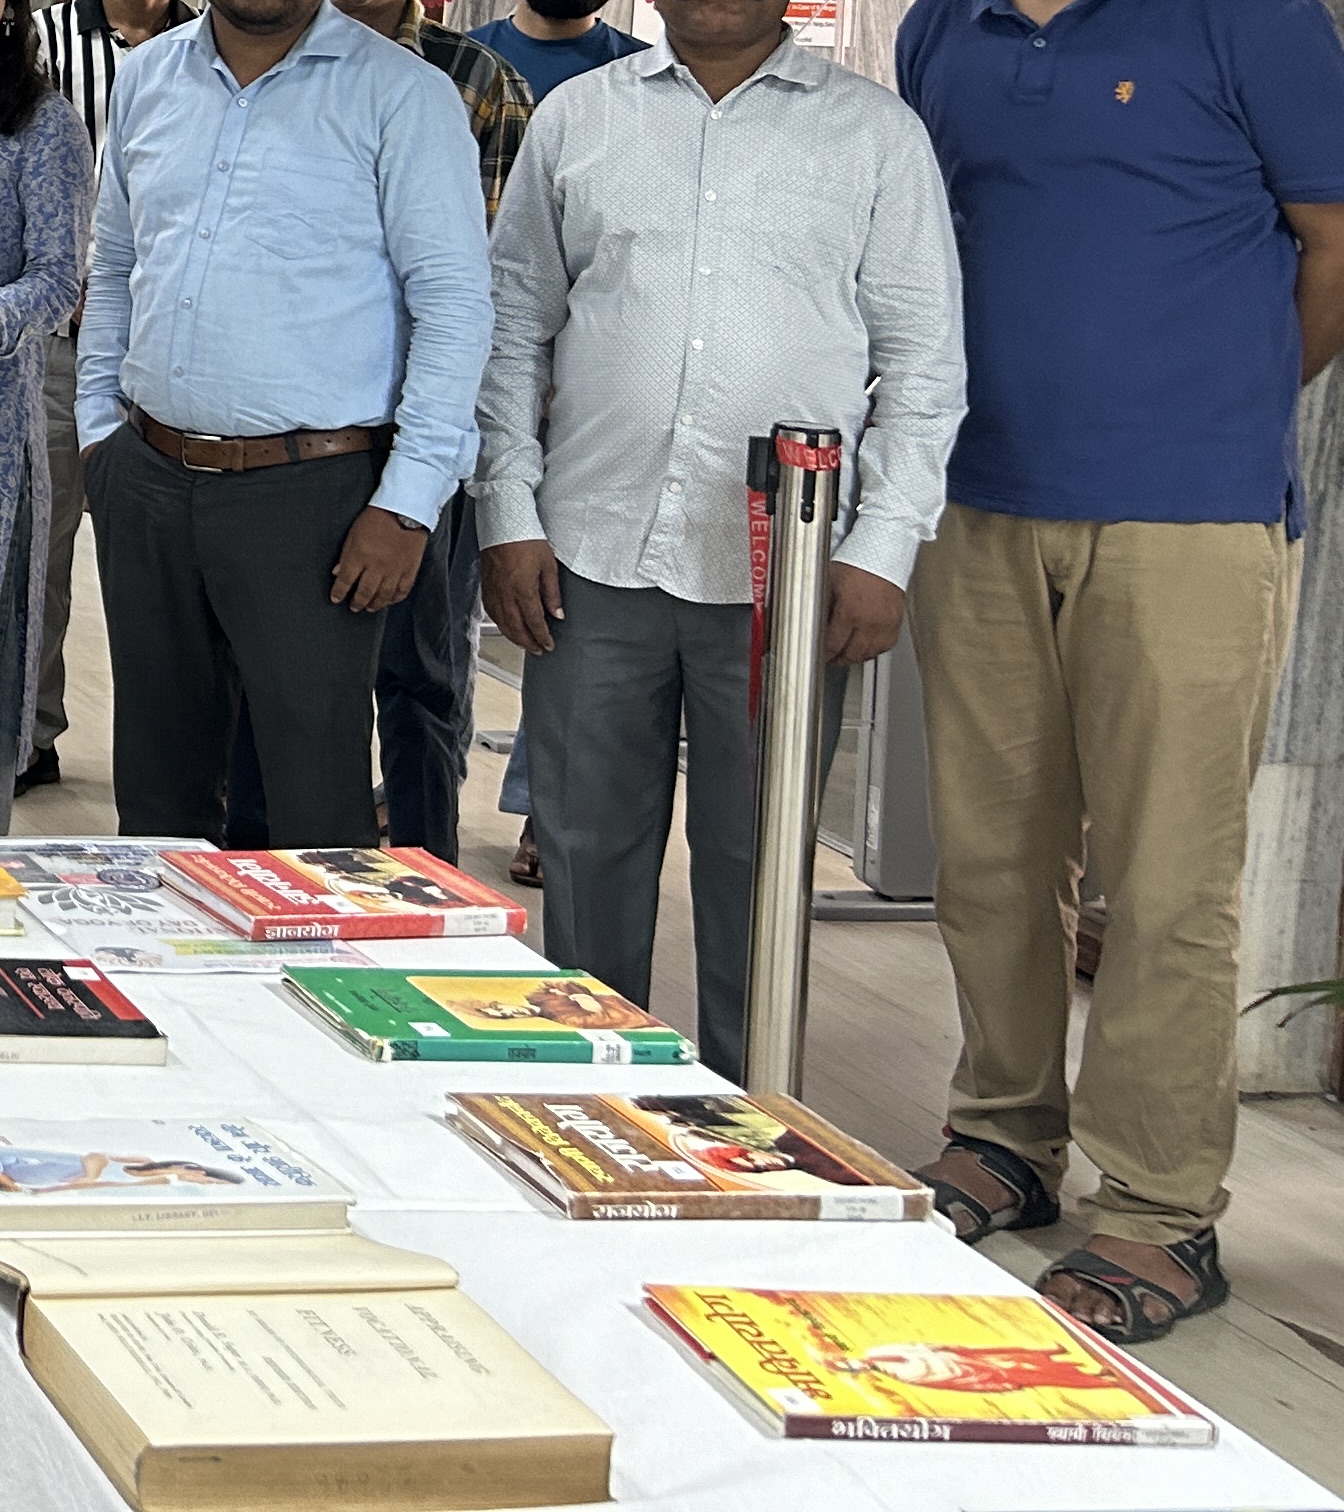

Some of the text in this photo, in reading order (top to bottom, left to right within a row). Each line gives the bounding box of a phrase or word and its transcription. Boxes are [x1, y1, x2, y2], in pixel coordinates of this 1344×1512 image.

[265, 924, 339, 939] ज्ञानयोग
[542, 1104, 669, 1173] राजयोग
[694, 1290, 835, 1400] भक्तियोग
[831, 1416, 951, 1441] भक्तियोग
